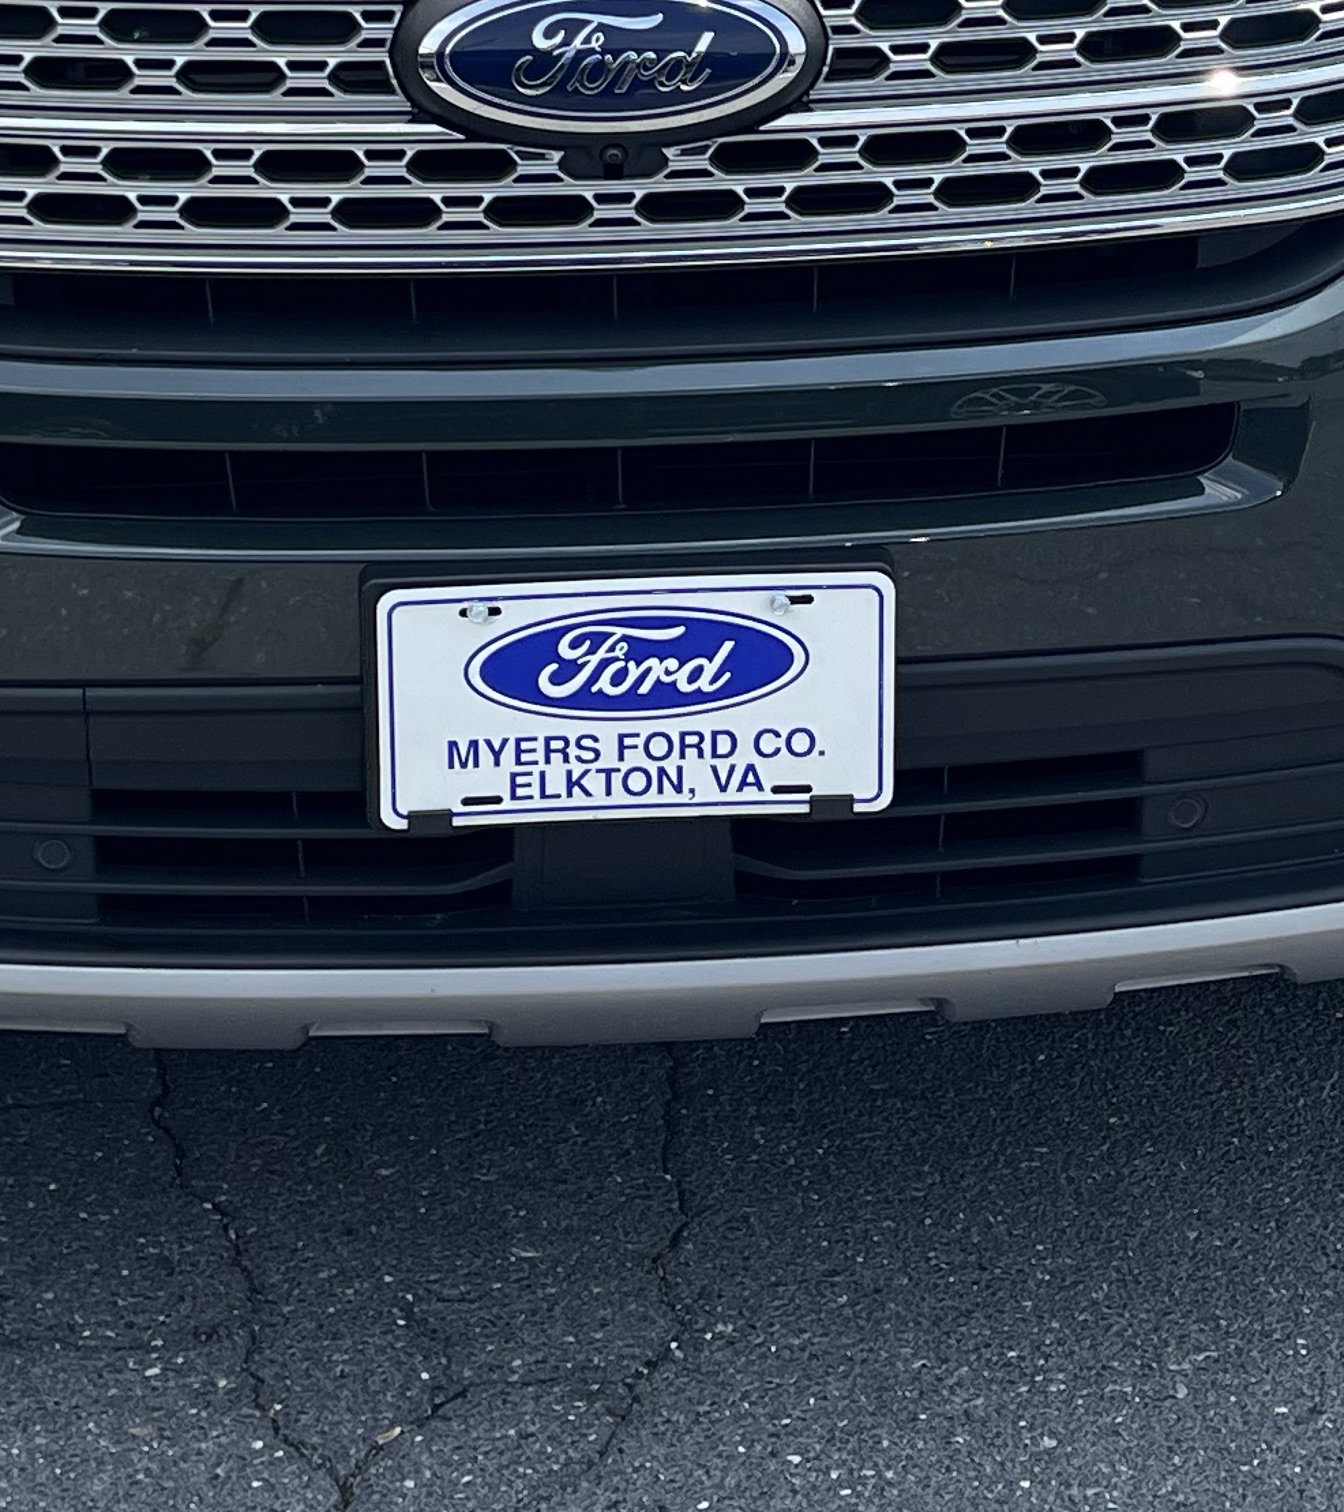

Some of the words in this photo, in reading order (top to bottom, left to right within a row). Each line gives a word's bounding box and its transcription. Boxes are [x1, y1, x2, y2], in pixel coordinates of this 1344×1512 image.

[512, 11, 715, 96] Ford
[538, 624, 736, 697] Ford
[447, 733, 602, 771] MYERS
[617, 729, 739, 763] FORD
[753, 727, 827, 759] CO.
[508, 764, 697, 802] ELKTON,
[712, 763, 765, 794] VA
